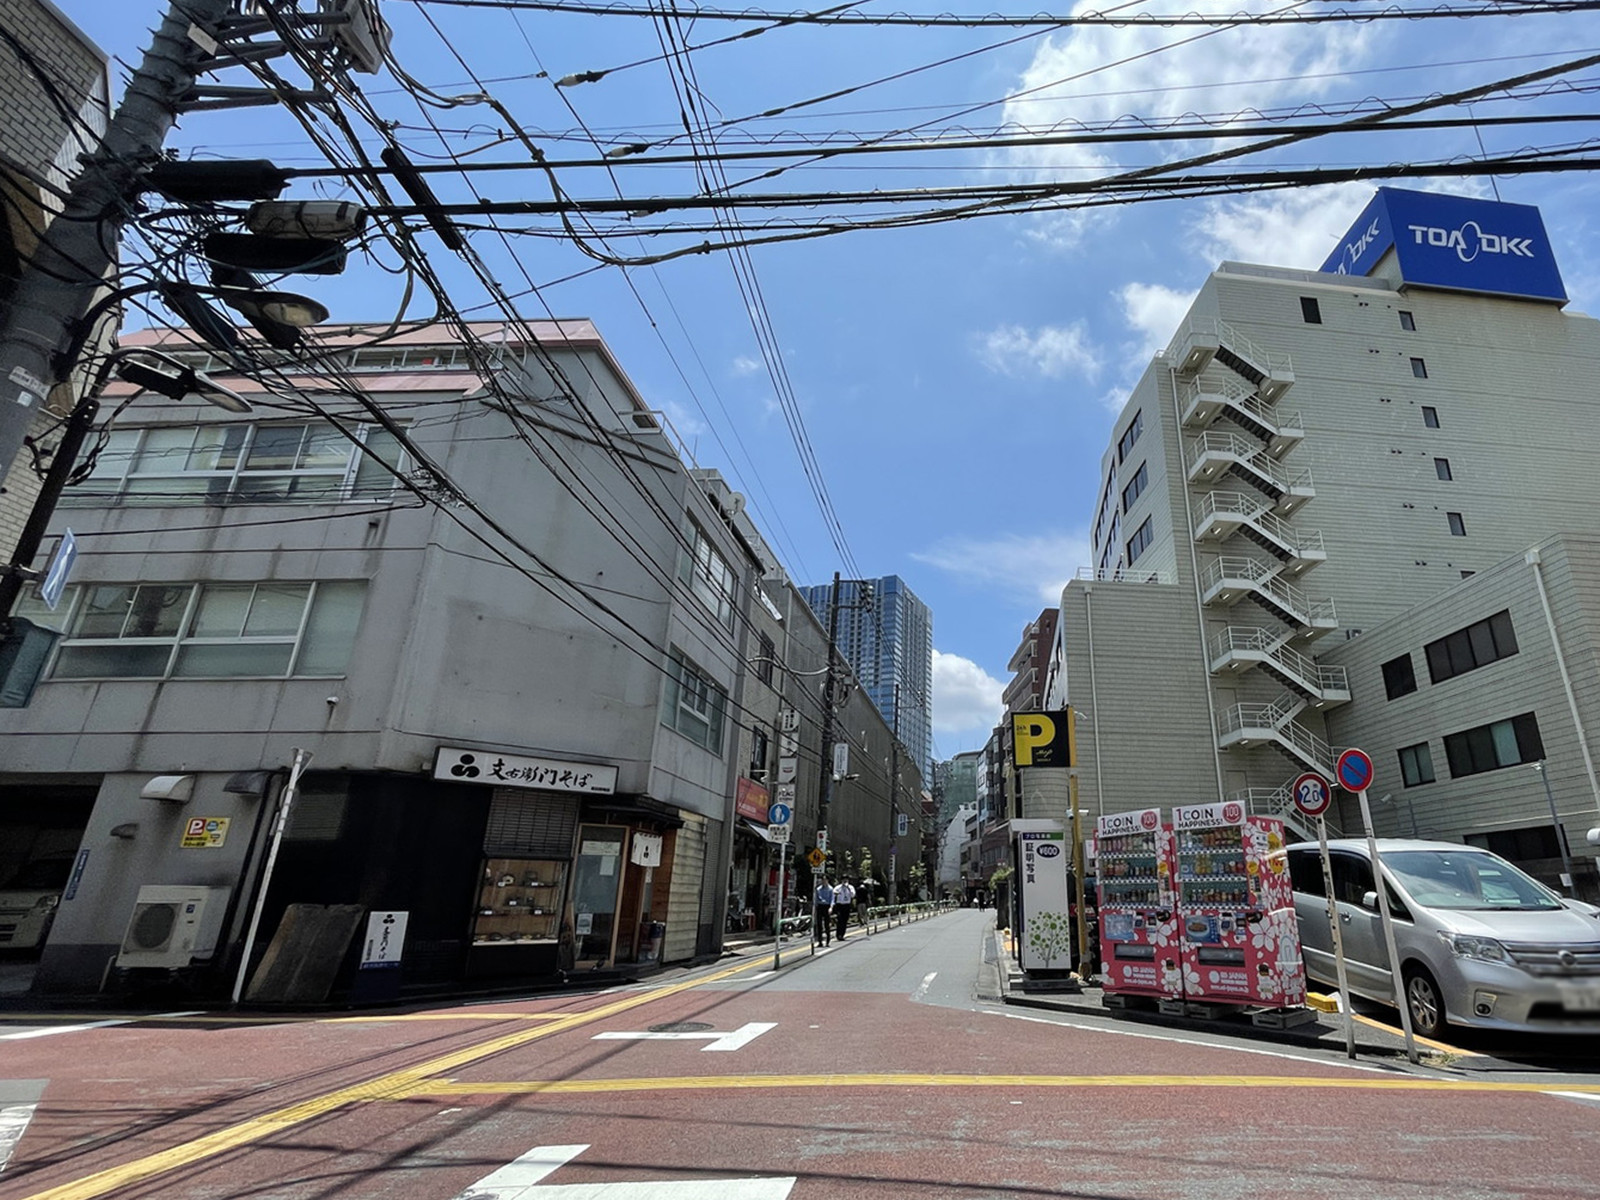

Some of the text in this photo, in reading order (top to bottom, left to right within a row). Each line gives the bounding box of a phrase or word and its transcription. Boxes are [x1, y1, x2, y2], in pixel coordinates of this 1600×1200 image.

[1013, 713, 1056, 766] P
[1177, 818, 1224, 828] HAPPINESS!
[1102, 824, 1142, 836] HAPPINESS!
